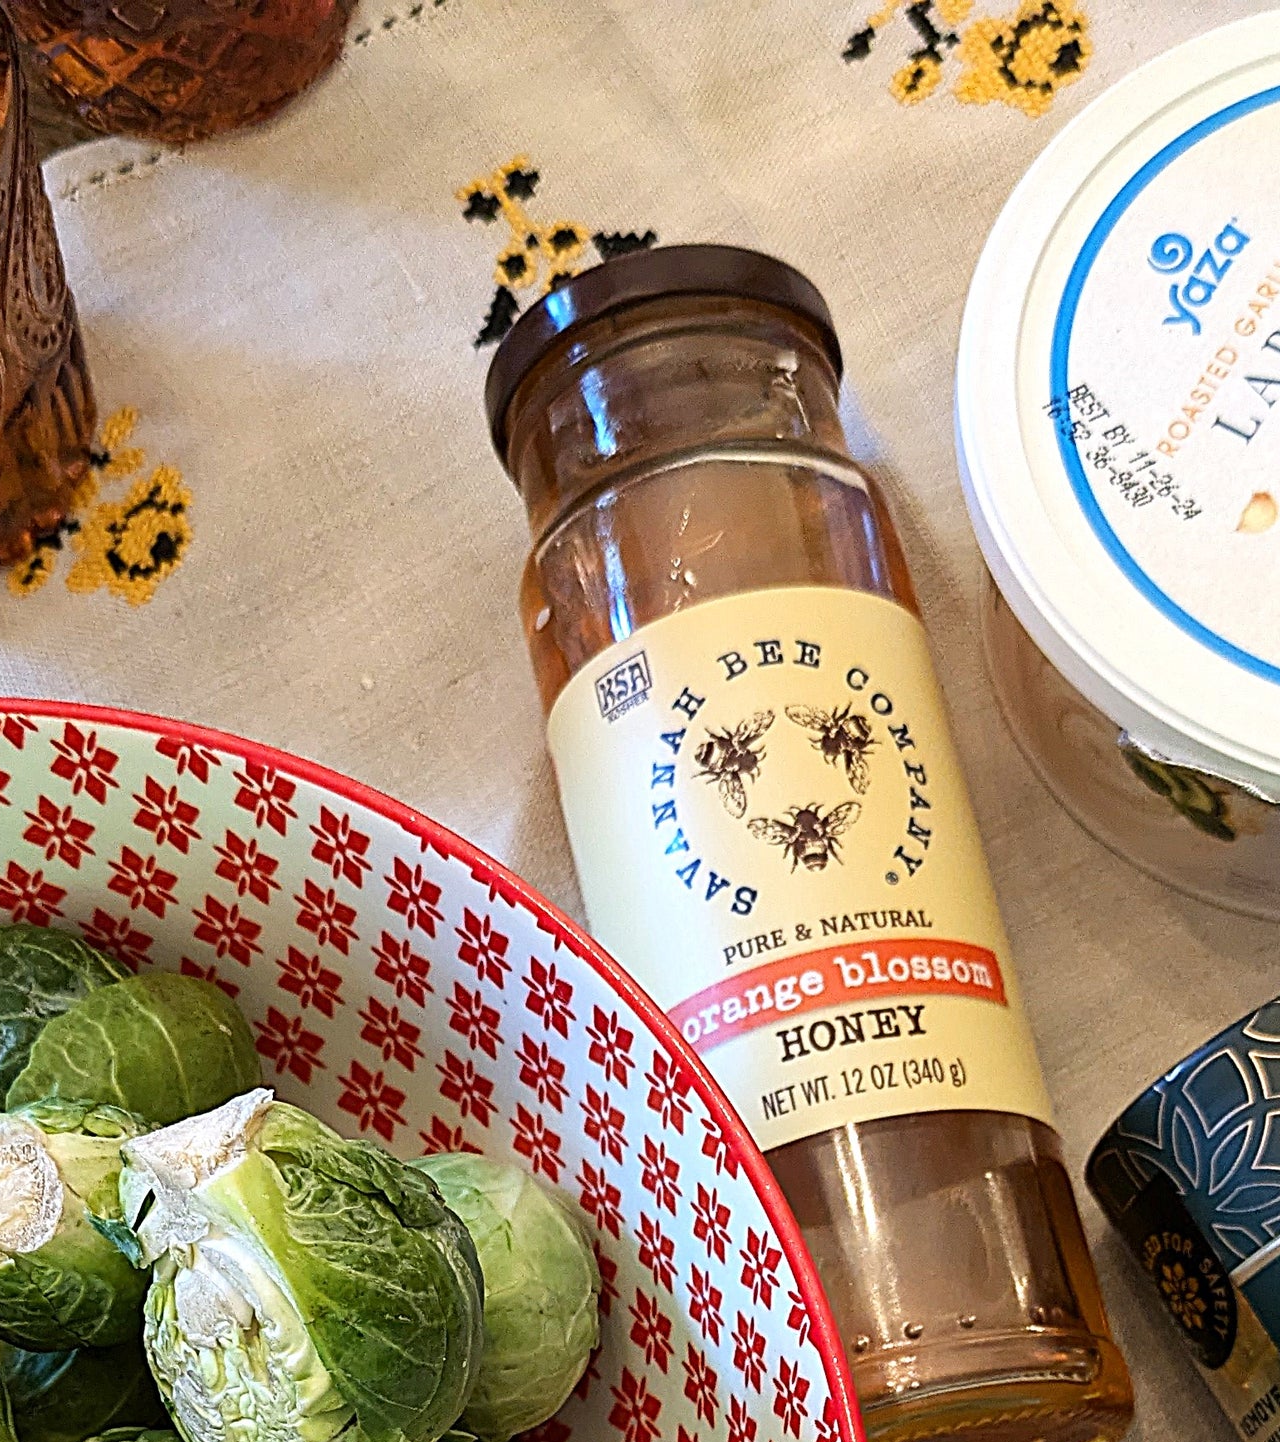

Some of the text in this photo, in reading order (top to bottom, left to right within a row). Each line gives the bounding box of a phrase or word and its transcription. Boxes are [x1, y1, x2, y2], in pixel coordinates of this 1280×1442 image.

[1162, 222, 1250, 336] yaza
[1066, 383, 1110, 423] BEST
[1102, 424, 1137, 447] BY
[1156, 346, 1238, 458] ROASTED
[599, 661, 647, 711] KSA
[651, 687, 758, 916] SAVANNAH
[717, 638, 821, 681] BEE
[723, 910, 932, 966] PURE & NATURAL
[682, 951, 993, 1044] orange blossom
[776, 1005, 927, 1063] HONEY
[762, 1057, 967, 1121] NET WT. 12 OZ (340 g)
[1162, 1231, 1192, 1258] FOR
[1199, 1258, 1229, 1340] SAFETY
